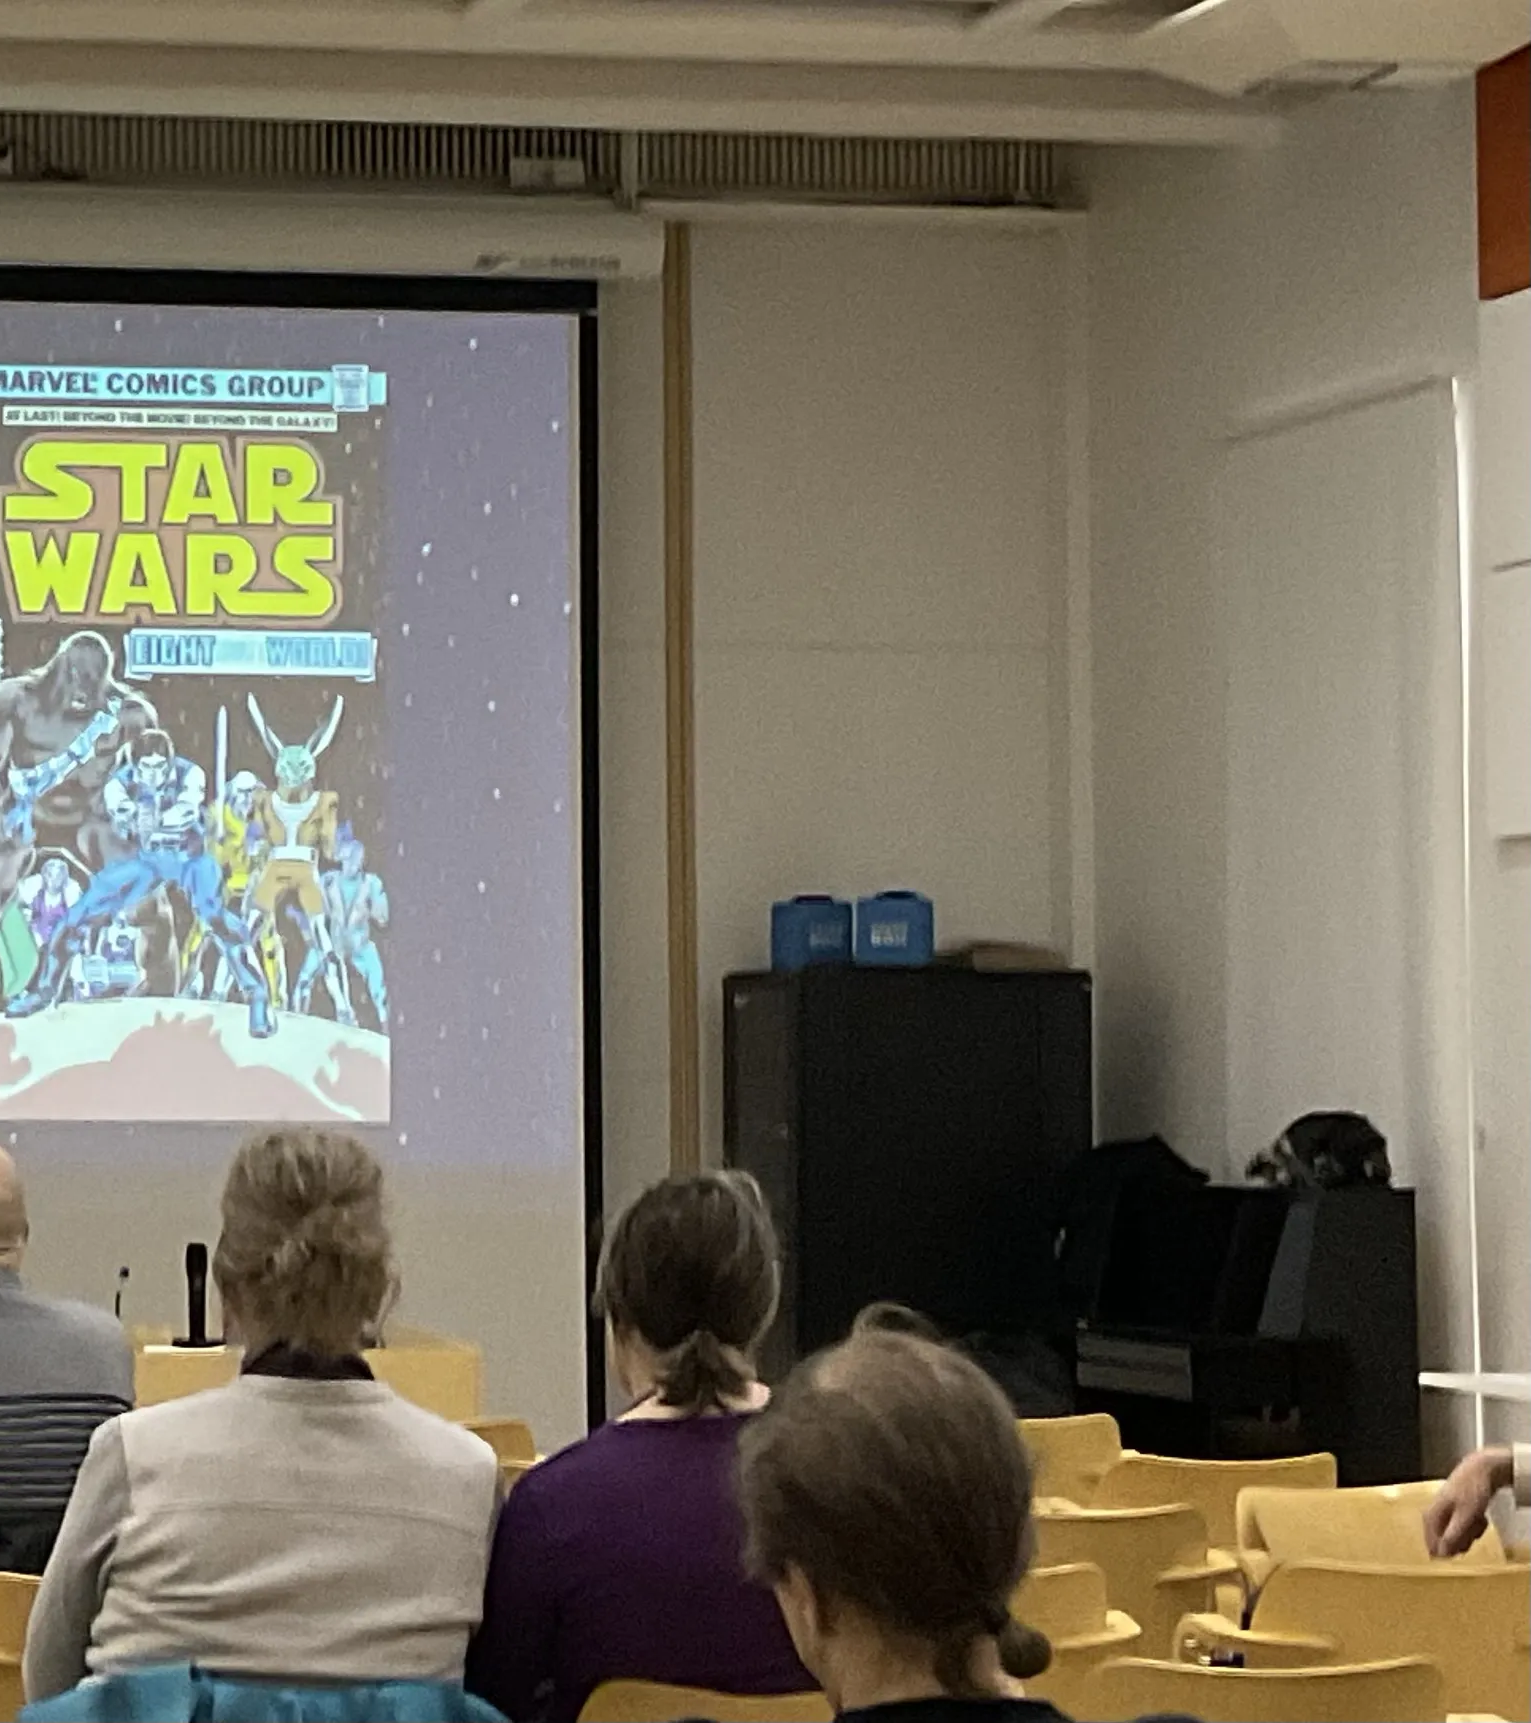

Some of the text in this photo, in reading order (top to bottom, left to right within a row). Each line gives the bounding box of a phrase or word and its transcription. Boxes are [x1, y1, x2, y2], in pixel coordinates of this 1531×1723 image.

[106, 372, 216, 396] COMICS
[228, 375, 325, 399] GROUP
[119, 412, 144, 423] THE
[249, 415, 273, 426] THE
[5, 441, 334, 525] STAR
[5, 530, 334, 616] WARS
[132, 634, 217, 667] EIGHT
